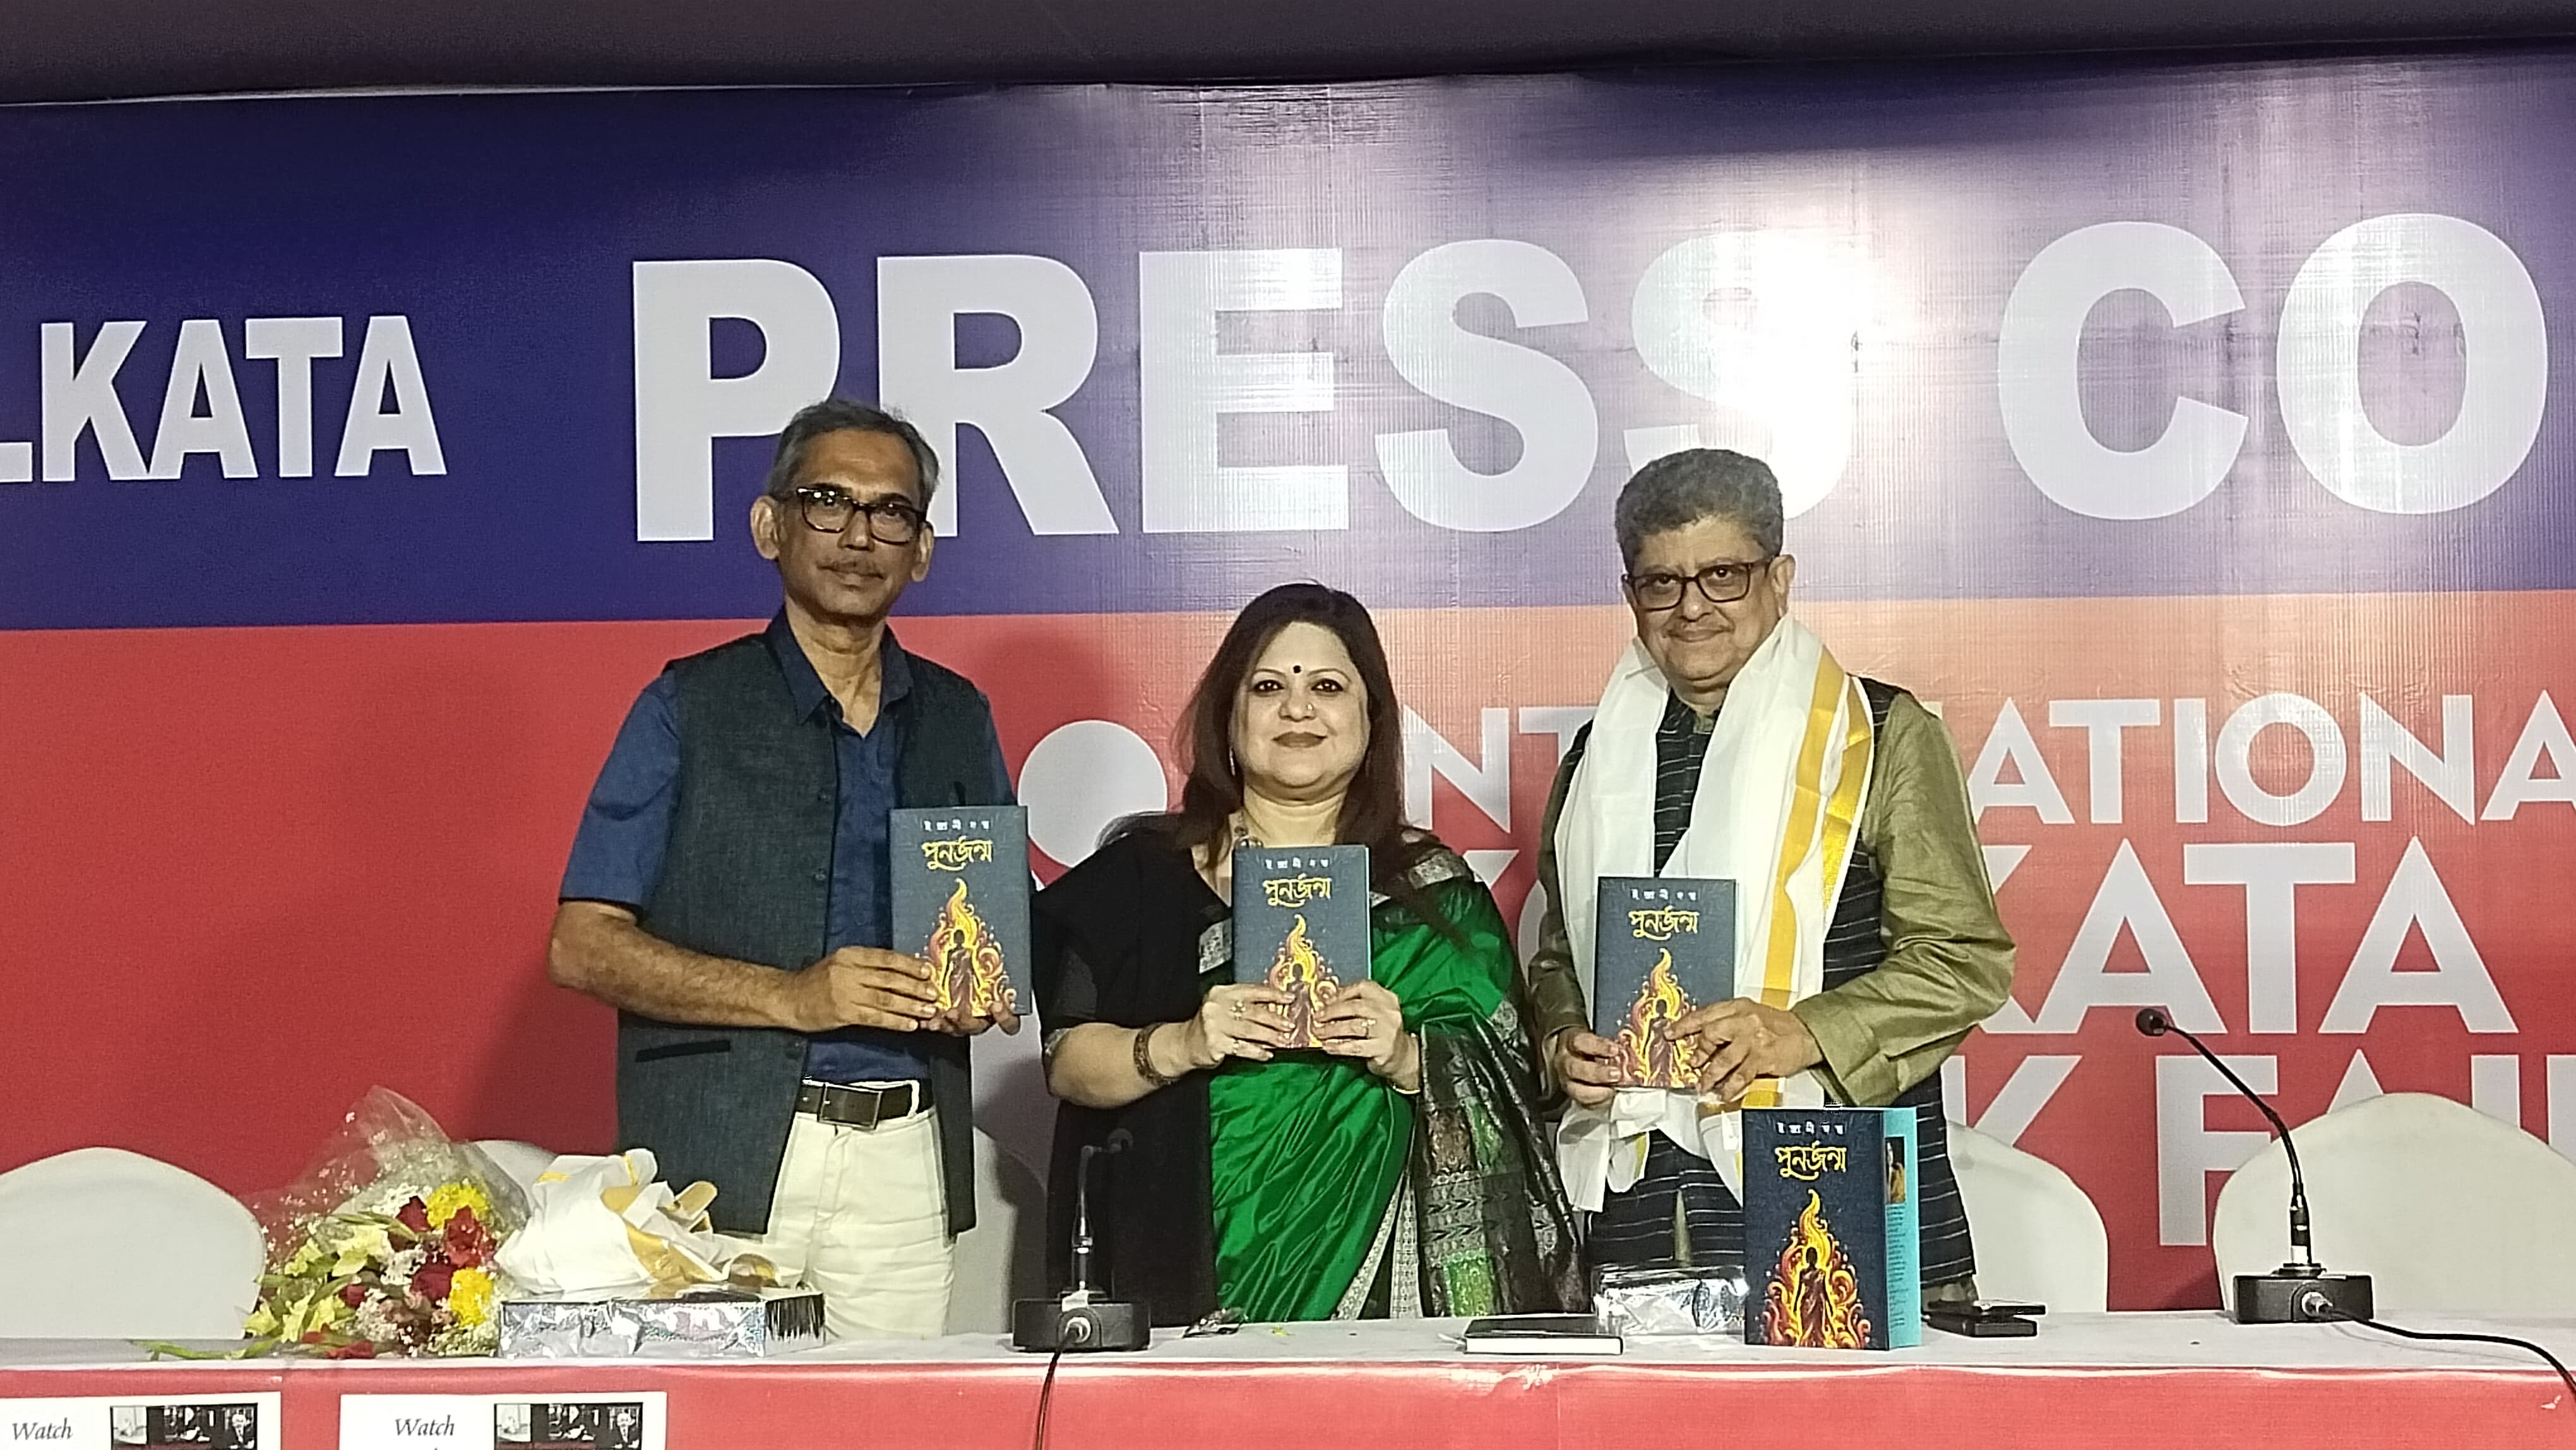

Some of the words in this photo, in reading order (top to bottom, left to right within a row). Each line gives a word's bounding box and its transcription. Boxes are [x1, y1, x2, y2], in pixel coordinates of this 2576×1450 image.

[0, 316, 447, 482] KATA
[633, 231, 1855, 541] PRESS
[1998, 213, 2548, 520] CO
[921, 836, 993, 871] পুনর্জন্ম
[1263, 873, 1332, 908] পুনর্জন্ম
[1628, 905, 1700, 940] পুনর্জন্ম
[1775, 1140, 1847, 1180] পুনর্জন্ম
[12, 1417, 73, 1441] Watch
[395, 1414, 455, 1436] Watch
